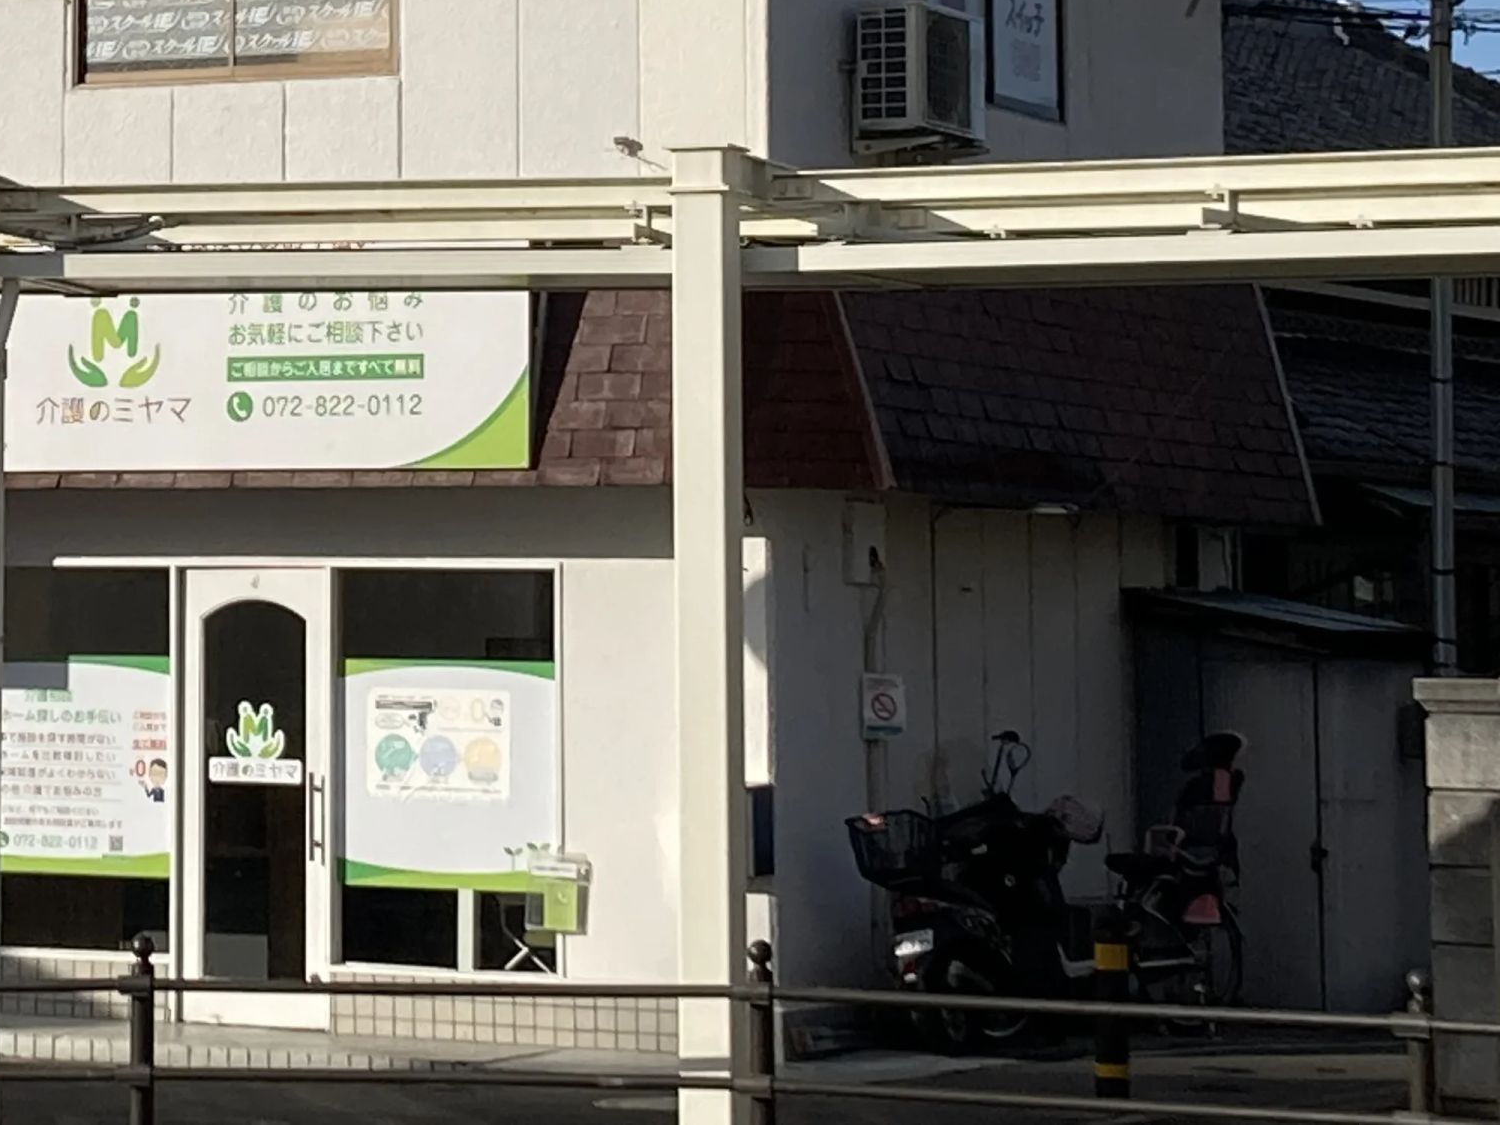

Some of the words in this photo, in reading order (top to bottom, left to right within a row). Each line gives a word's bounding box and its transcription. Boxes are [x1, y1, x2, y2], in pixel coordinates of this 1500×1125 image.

[228, 321, 424, 346] お気軽にご相談下さい
[36, 397, 192, 424] 介護のミヤマ
[262, 394, 423, 418] 072-822-0112
[213, 761, 298, 778] 介護のミヤマ
